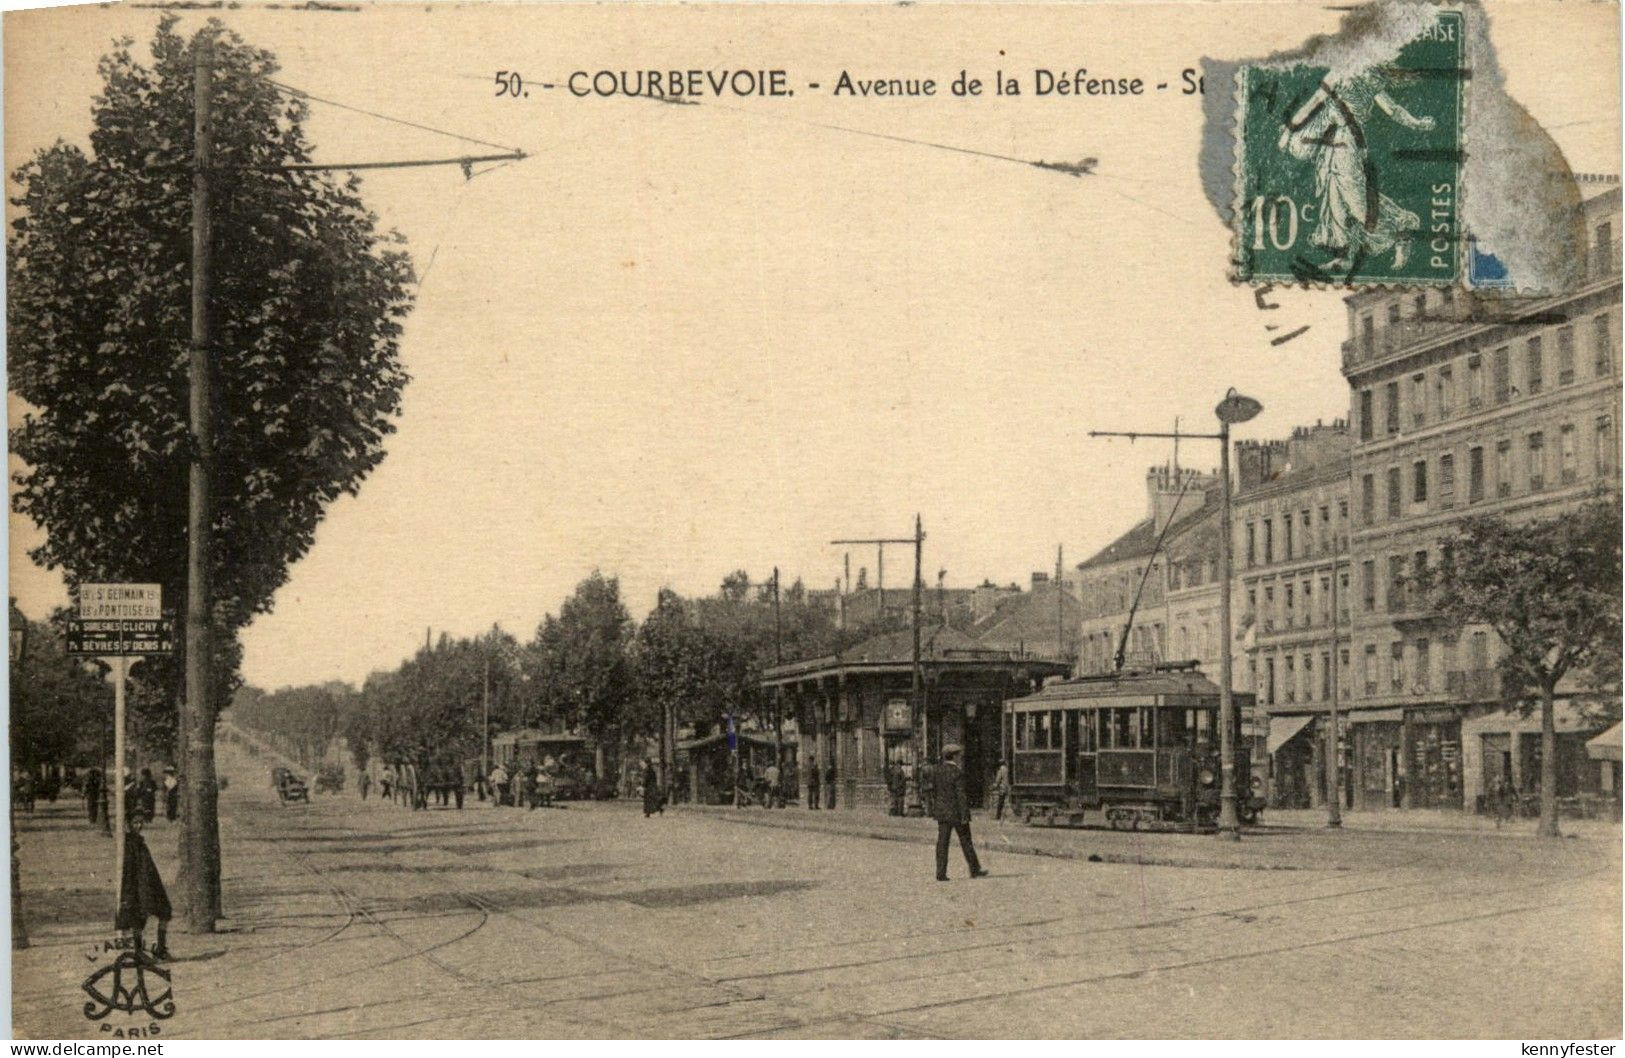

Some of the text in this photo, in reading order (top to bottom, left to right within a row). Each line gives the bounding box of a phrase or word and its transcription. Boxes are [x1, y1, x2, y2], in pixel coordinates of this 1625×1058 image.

[1430, 182, 1452, 269] POSTES
[99, 604, 143, 617] PONTOISE
[122, 622, 158, 632] CLICHY
